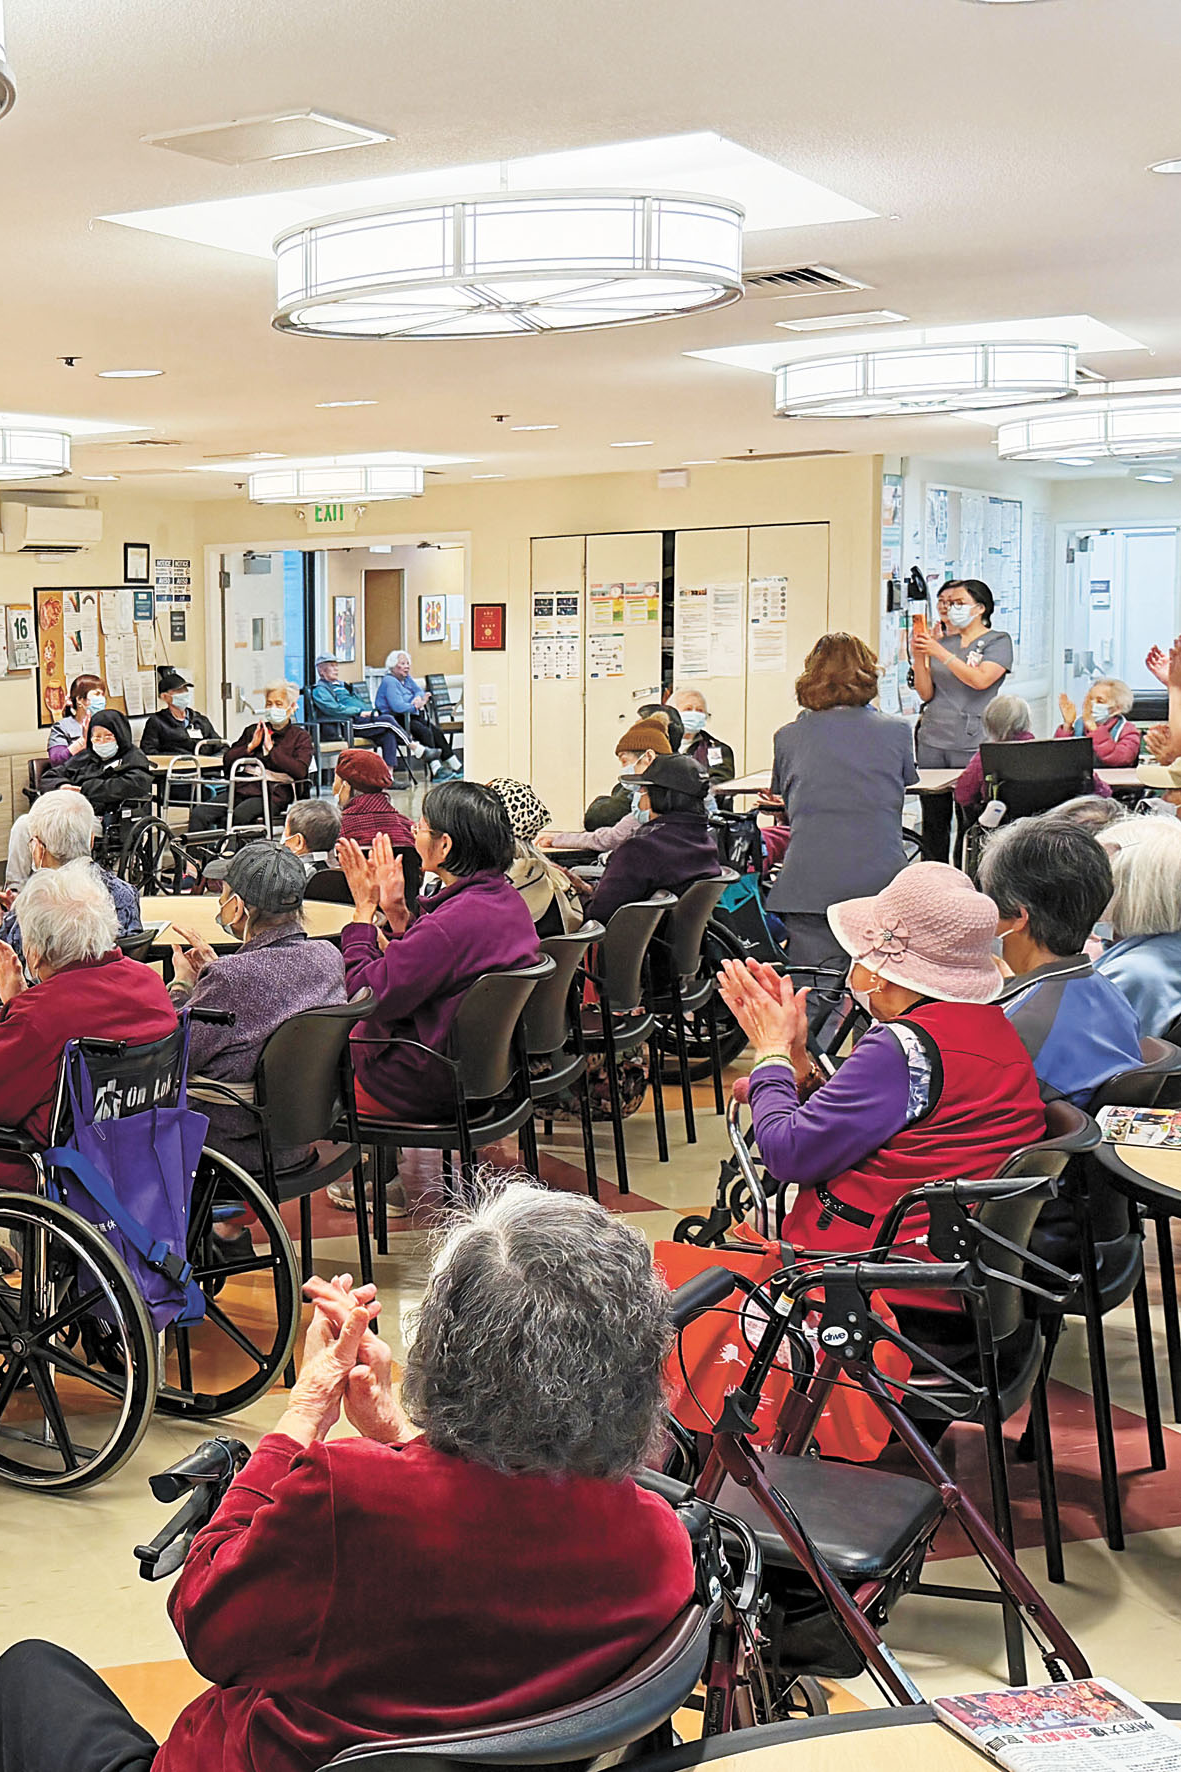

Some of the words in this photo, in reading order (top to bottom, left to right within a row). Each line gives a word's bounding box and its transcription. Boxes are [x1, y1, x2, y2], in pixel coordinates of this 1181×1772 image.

[14, 617, 28, 640] 16
[126, 1085, 147, 1108] On
[153, 1072, 173, 1101] Lok
[824, 1332, 846, 1341] drive
